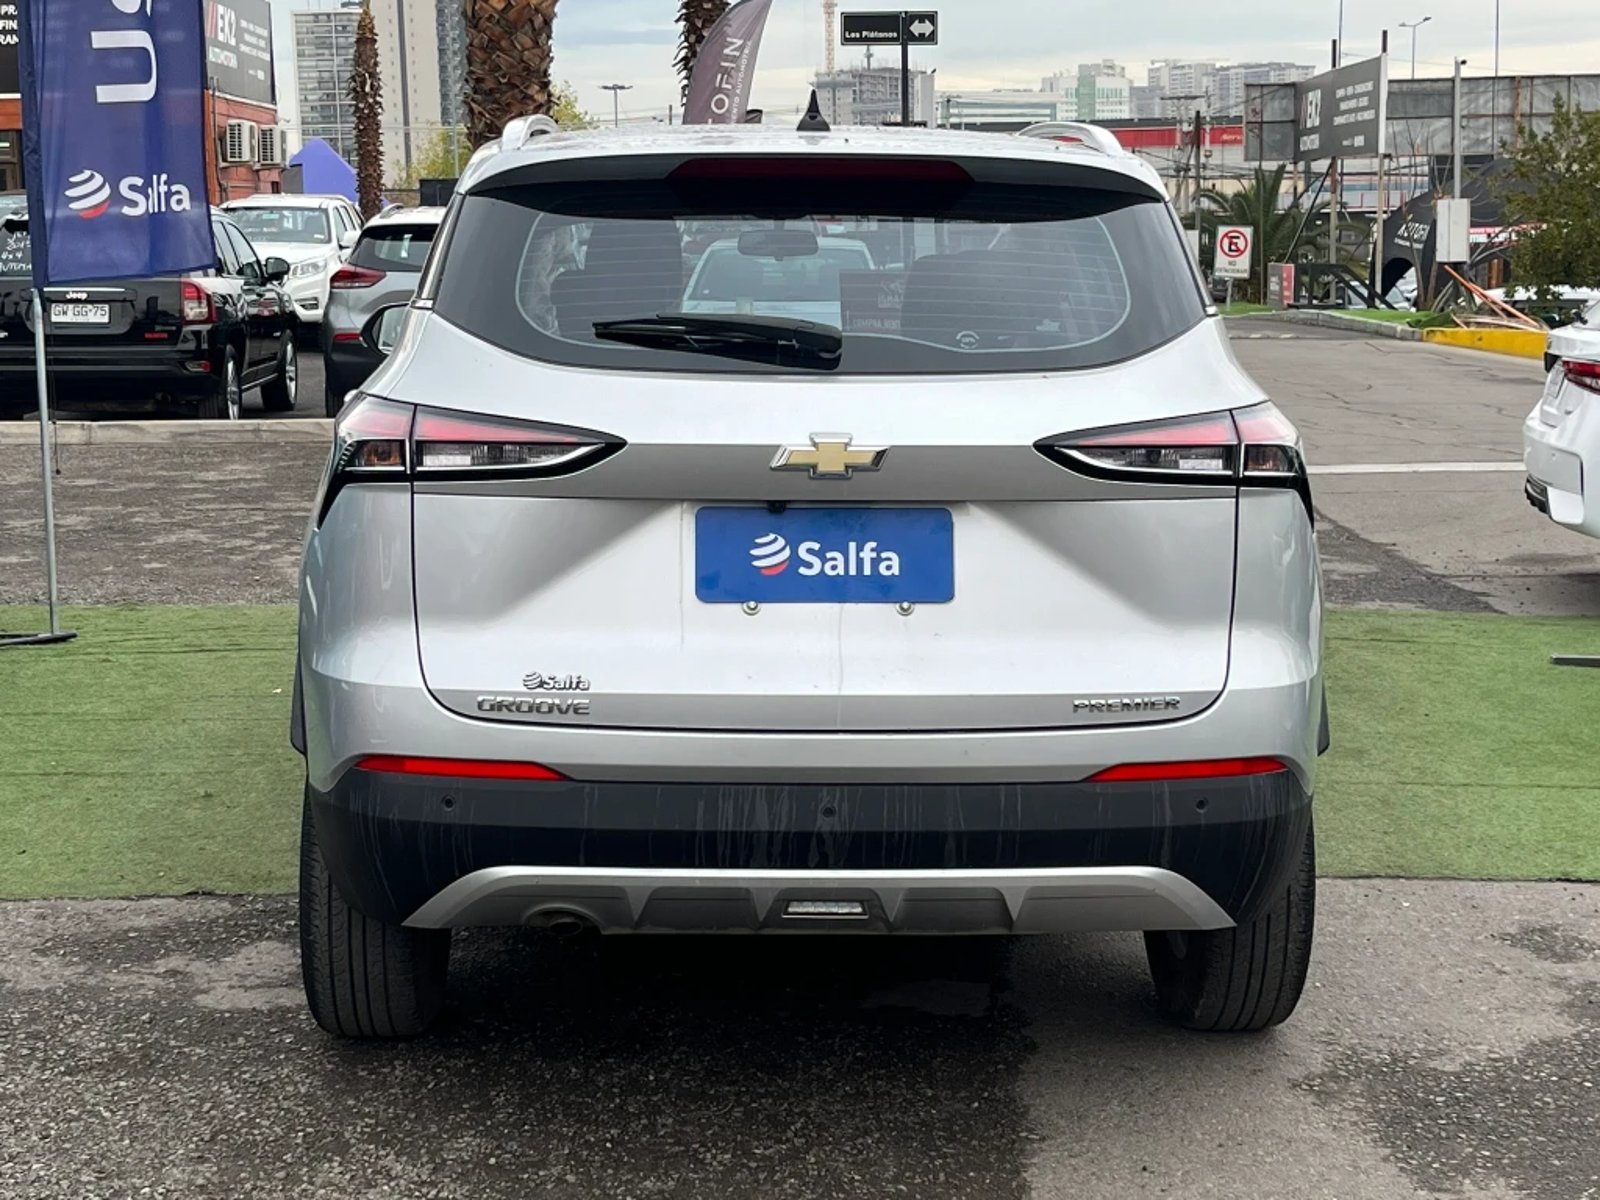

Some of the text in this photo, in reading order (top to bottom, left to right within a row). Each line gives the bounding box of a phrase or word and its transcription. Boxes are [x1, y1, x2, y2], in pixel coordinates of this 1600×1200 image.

[707, 36, 744, 124] OFIN
[119, 172, 191, 217] Slfa
[66, 292, 88, 300] Jeep
[798, 541, 900, 576] Salfa
[543, 675, 591, 691] Salfa
[477, 695, 590, 715] GROOVE
[1072, 696, 1181, 713] PREMIER
